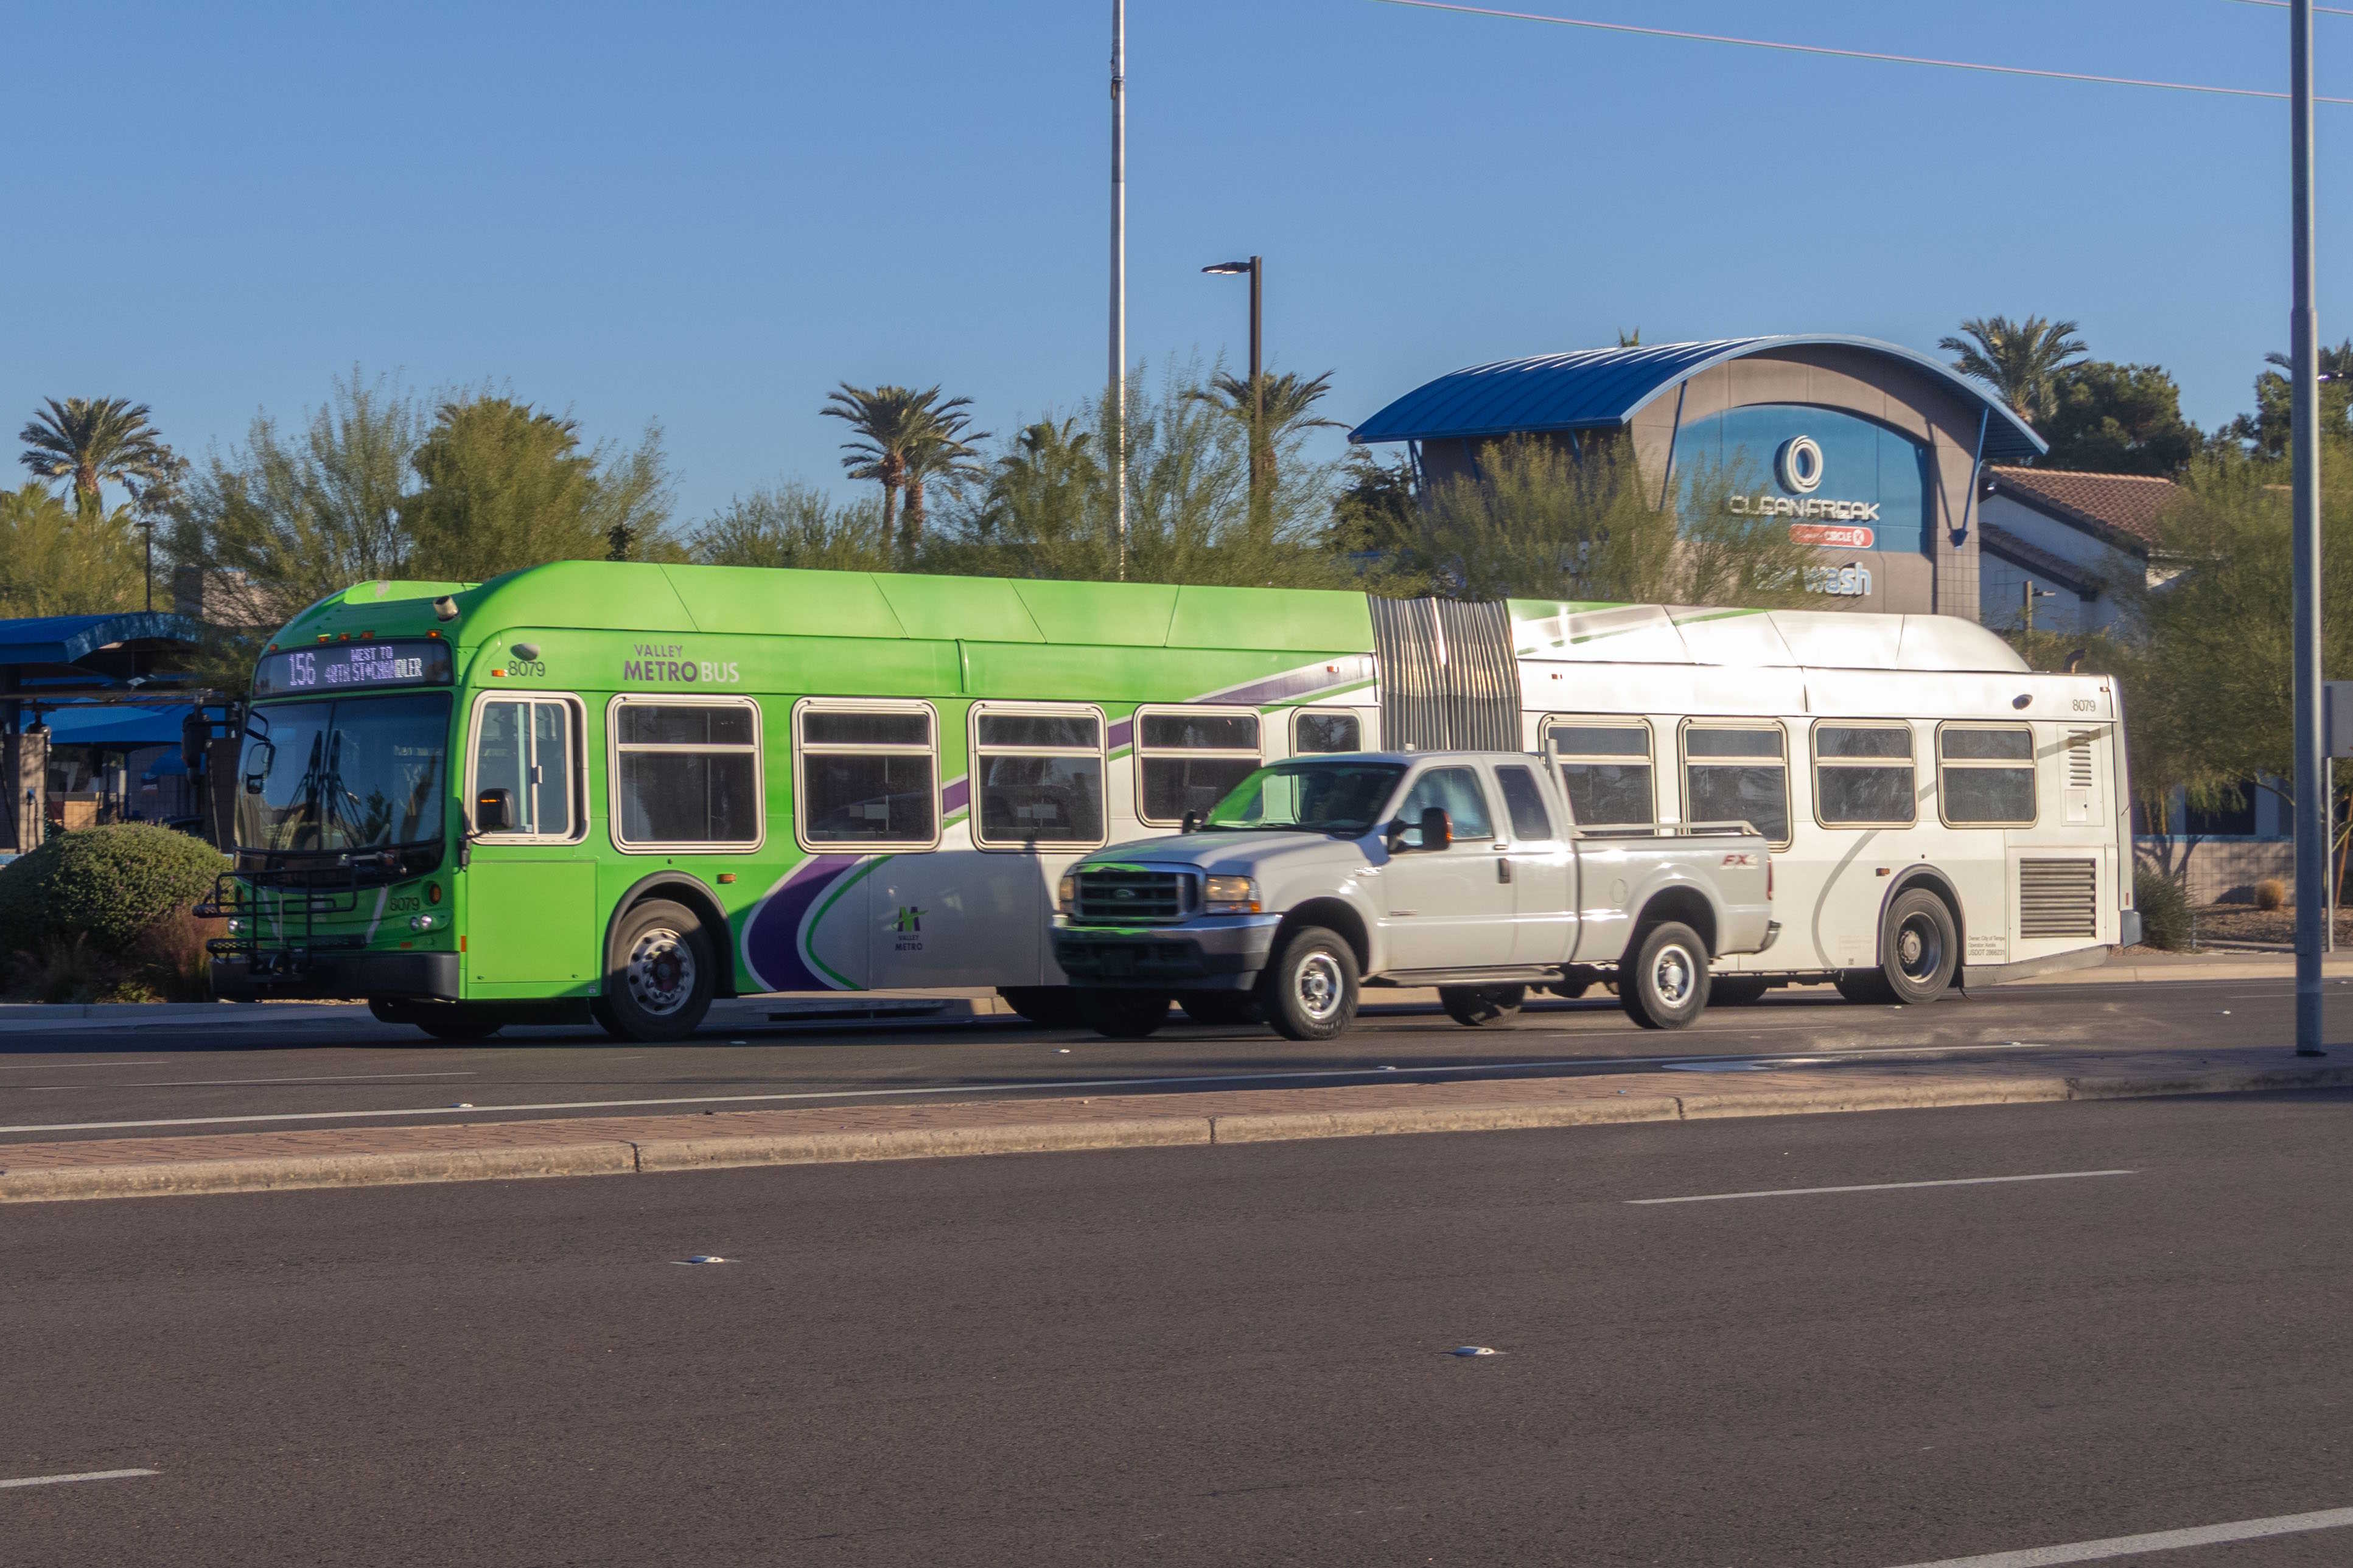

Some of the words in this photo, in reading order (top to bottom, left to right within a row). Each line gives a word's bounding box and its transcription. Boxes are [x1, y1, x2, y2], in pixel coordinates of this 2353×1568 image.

[1823, 531, 1852, 542] CIRCLE
[1802, 562, 1872, 596] wash
[351, 648, 376, 662] WEST
[380, 646, 394, 660] TO
[634, 644, 683, 658] VALLEY
[289, 653, 316, 686] 156
[508, 661, 545, 677] 8079
[2072, 699, 2096, 712] 8079
[390, 897, 420, 911] 8079
[895, 943, 923, 951] METRO
